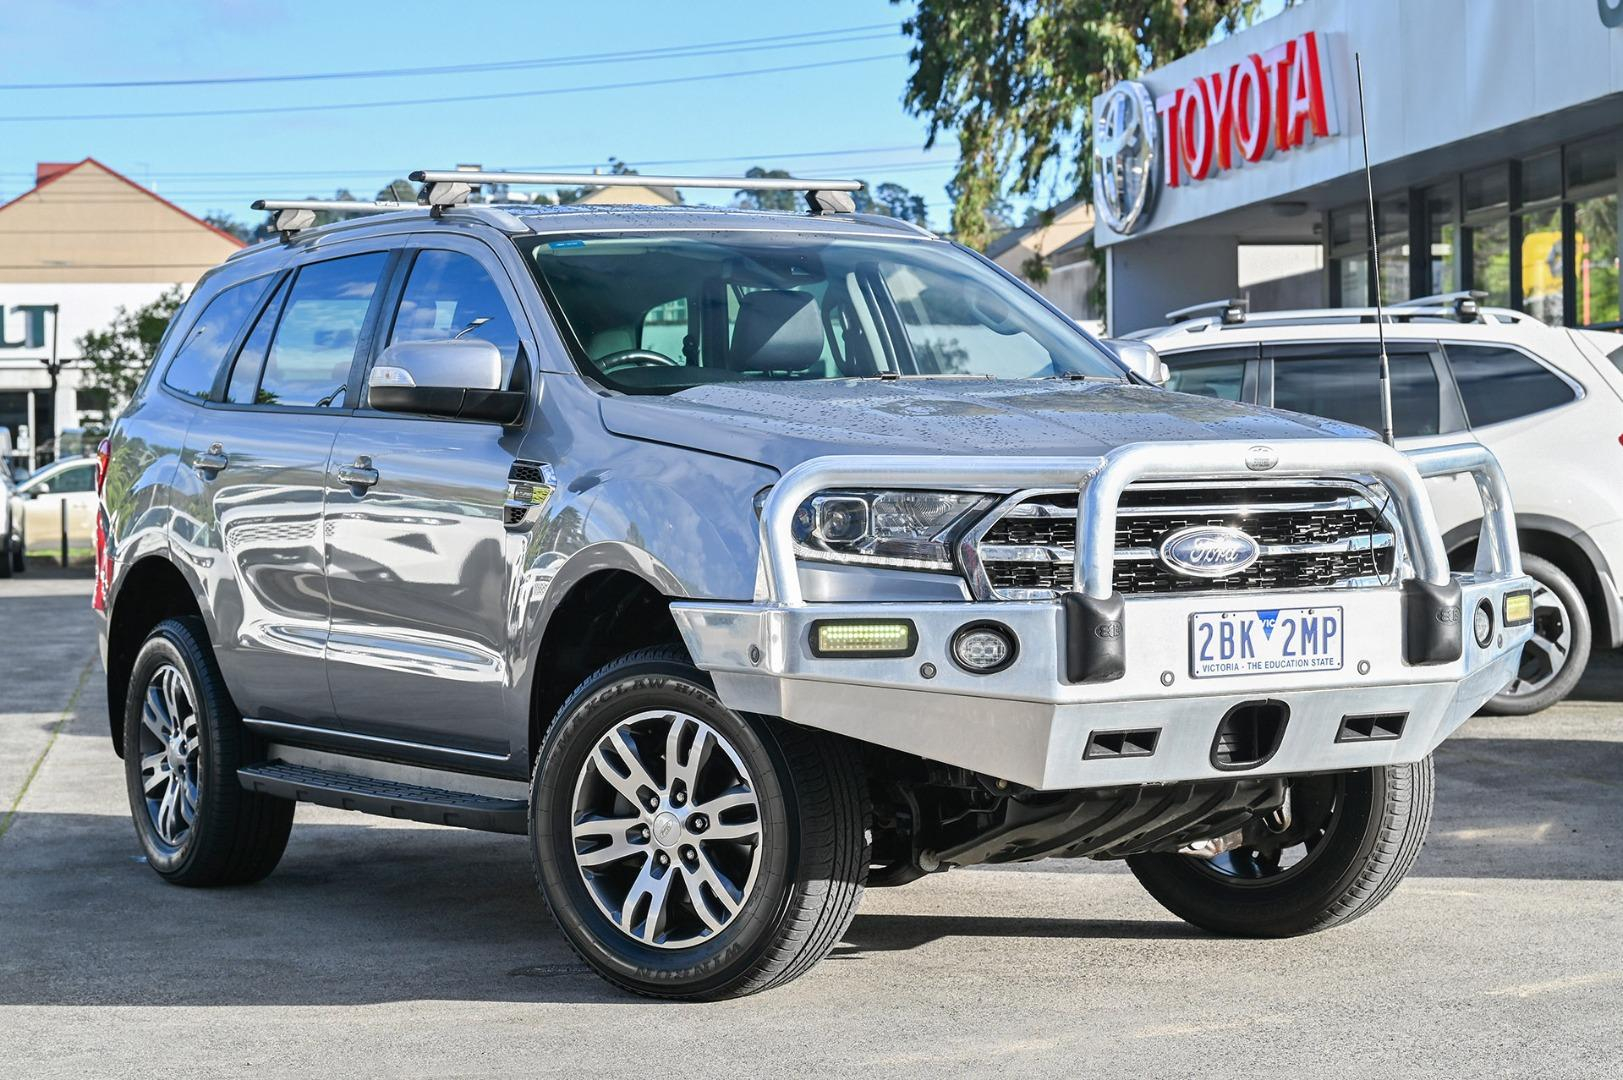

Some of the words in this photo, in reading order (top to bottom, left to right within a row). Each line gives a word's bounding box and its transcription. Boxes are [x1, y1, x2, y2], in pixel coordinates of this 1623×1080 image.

[1156, 31, 1328, 188] TOYOTA
[1190, 535, 1239, 564] Ford
[1260, 618, 1276, 628] VIC
[1198, 620, 1255, 661] 2BK
[1281, 616, 1337, 656] 2MP
[1202, 662, 1239, 673] VICTORIA
[1247, 661, 1262, 670] THE
[1264, 659, 1309, 669] EDUCATION
[1311, 657, 1334, 667] STATE
